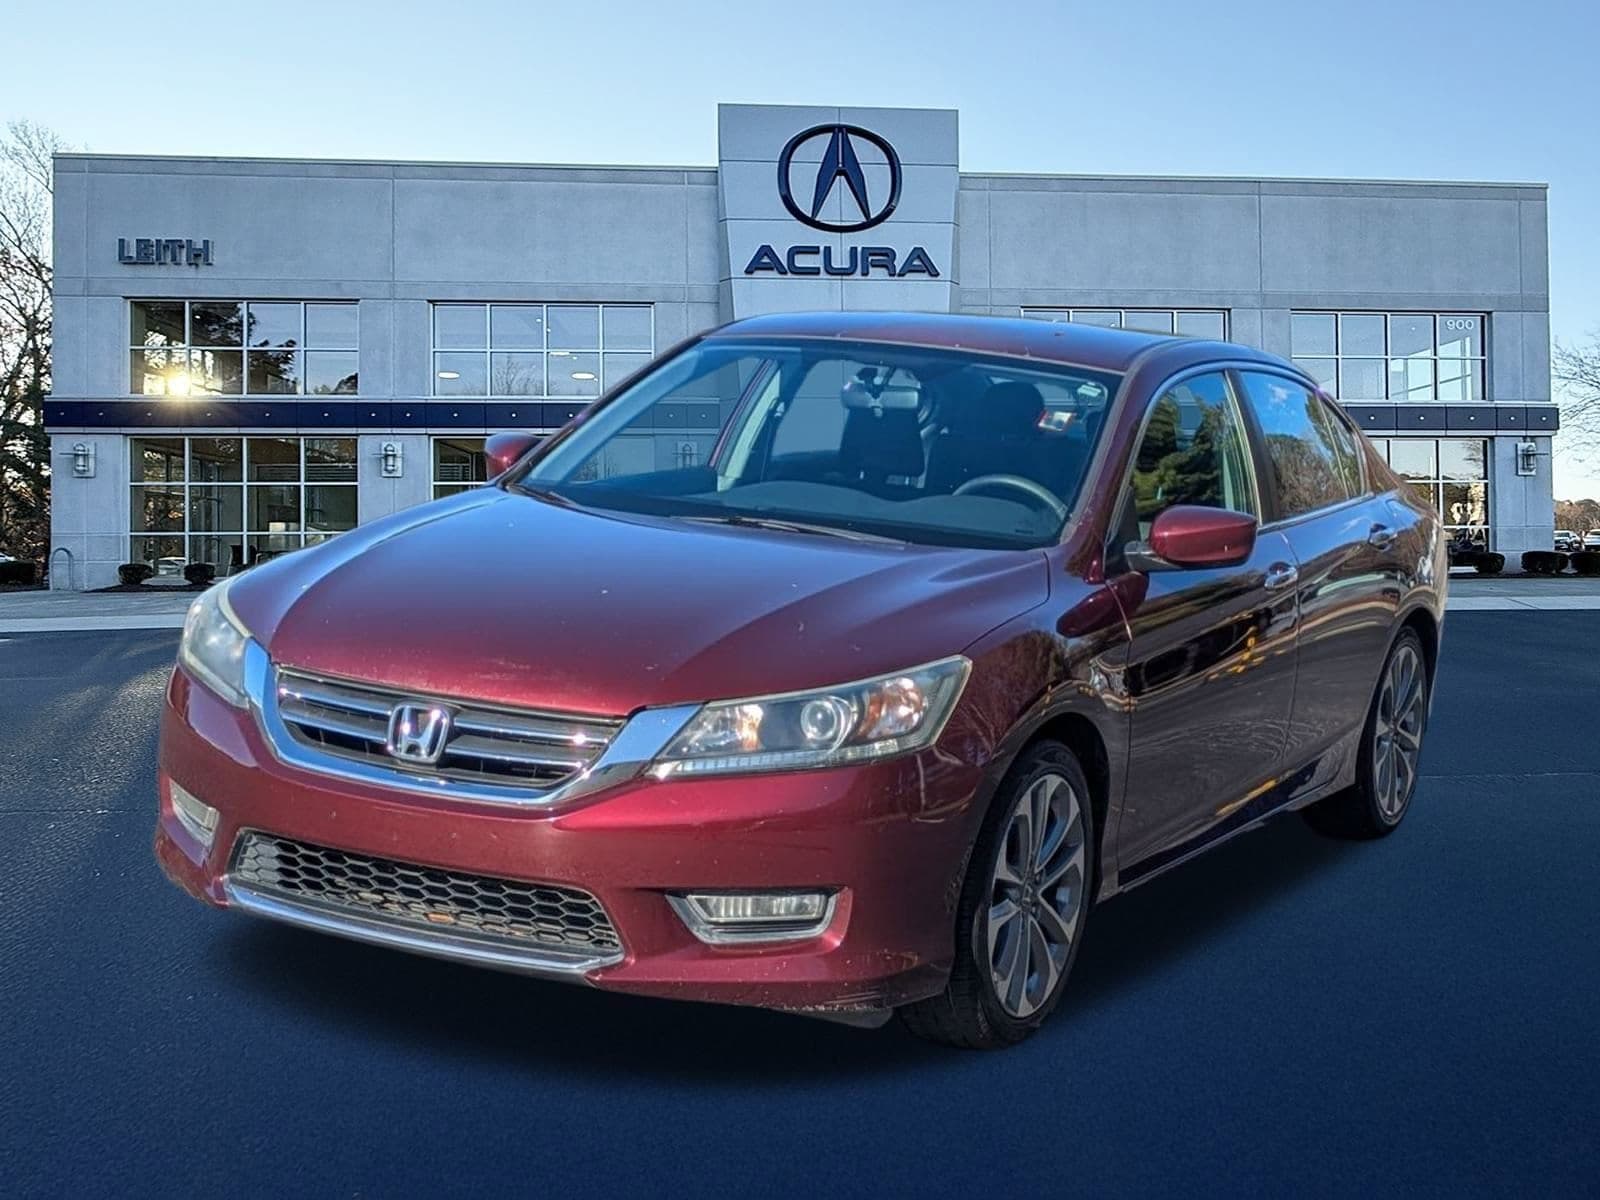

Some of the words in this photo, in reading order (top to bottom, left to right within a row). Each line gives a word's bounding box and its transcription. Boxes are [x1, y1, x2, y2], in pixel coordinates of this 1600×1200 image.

[118, 238, 213, 266] LEITH
[744, 244, 940, 277] ACURA
[1446, 319, 1474, 330] 900
